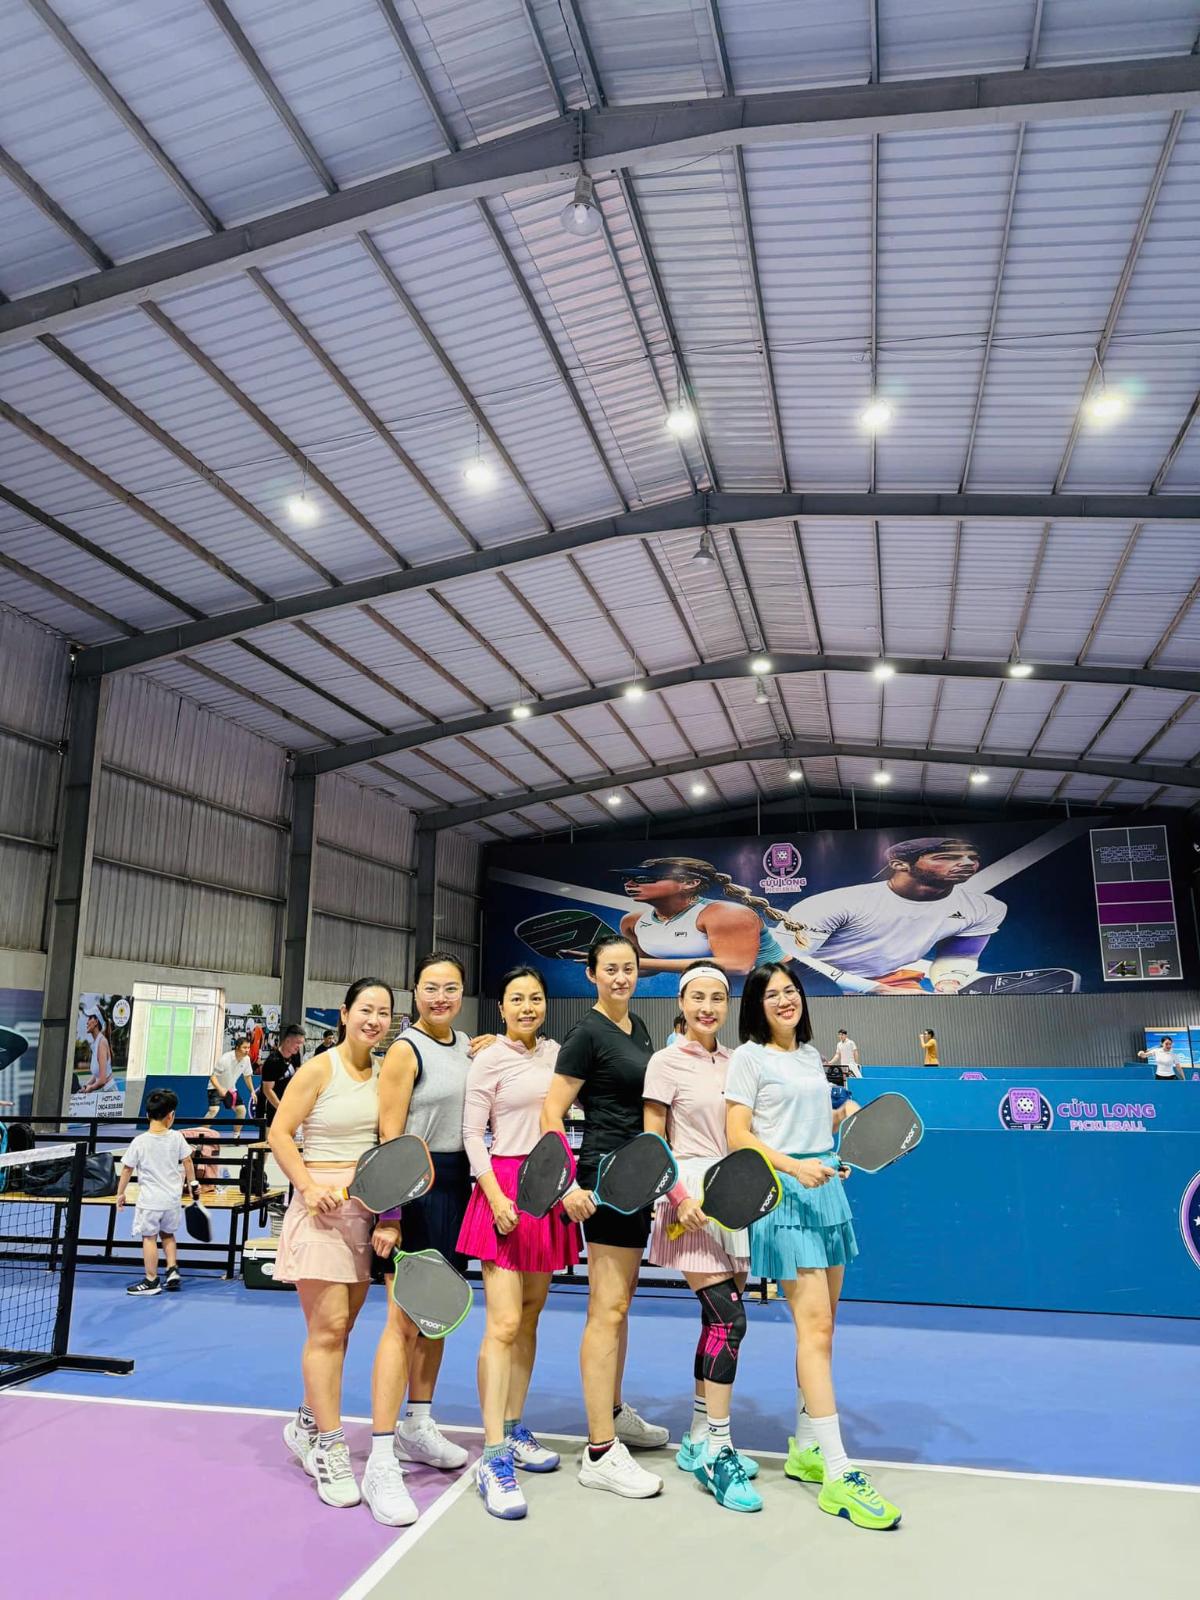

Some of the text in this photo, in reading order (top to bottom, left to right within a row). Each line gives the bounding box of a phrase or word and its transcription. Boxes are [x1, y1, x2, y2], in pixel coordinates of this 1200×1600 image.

[781, 877, 807, 887] LONG
[1057, 1098, 1156, 1119] CỬU LONG
[1070, 1120, 1146, 1131] PICKLEBALL
[901, 1127, 915, 1149] JOOLA
[655, 1172, 669, 1193] JOOLA
[760, 1191, 773, 1212] JOOLA
